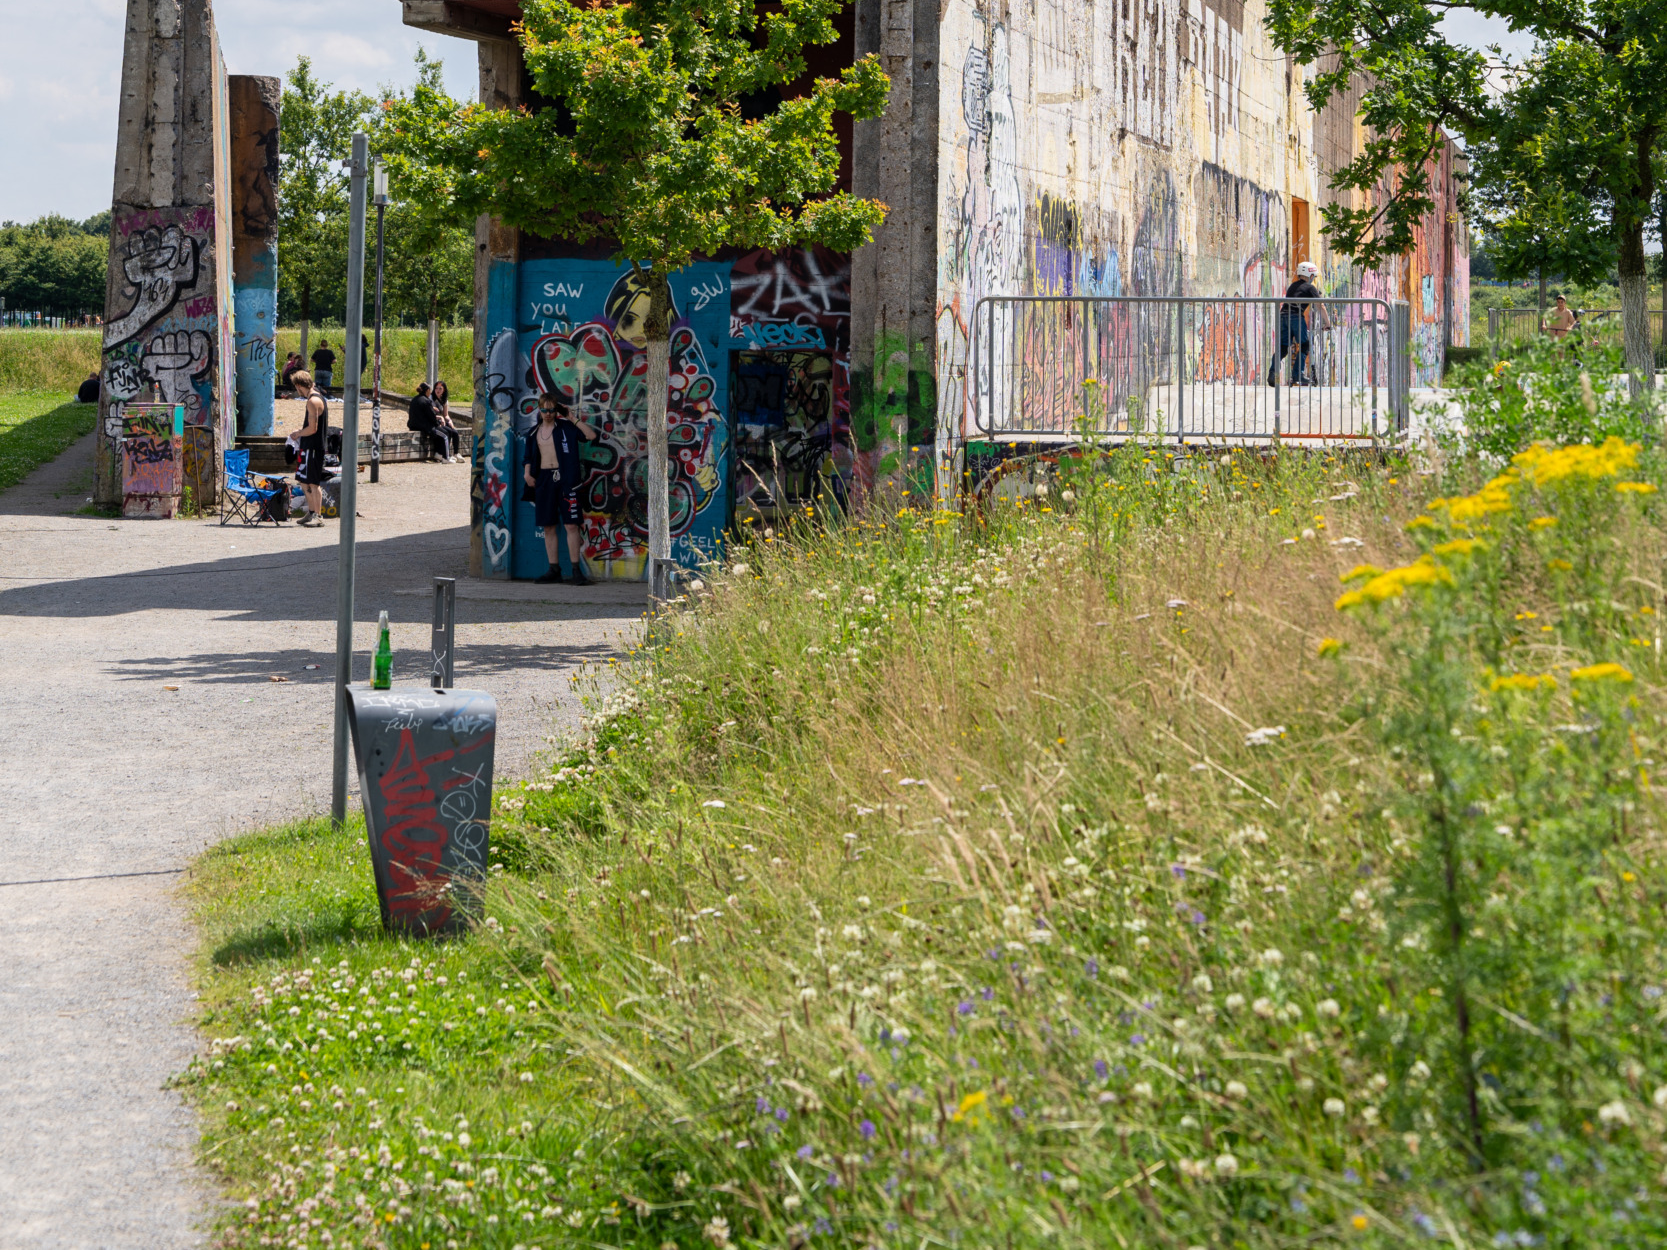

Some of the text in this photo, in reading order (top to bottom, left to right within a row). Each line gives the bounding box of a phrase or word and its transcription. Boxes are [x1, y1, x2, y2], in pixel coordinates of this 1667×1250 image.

[543, 282, 584, 299] SAW
[540, 319, 592, 336] LATE
[371, 406, 380, 459] BONG
